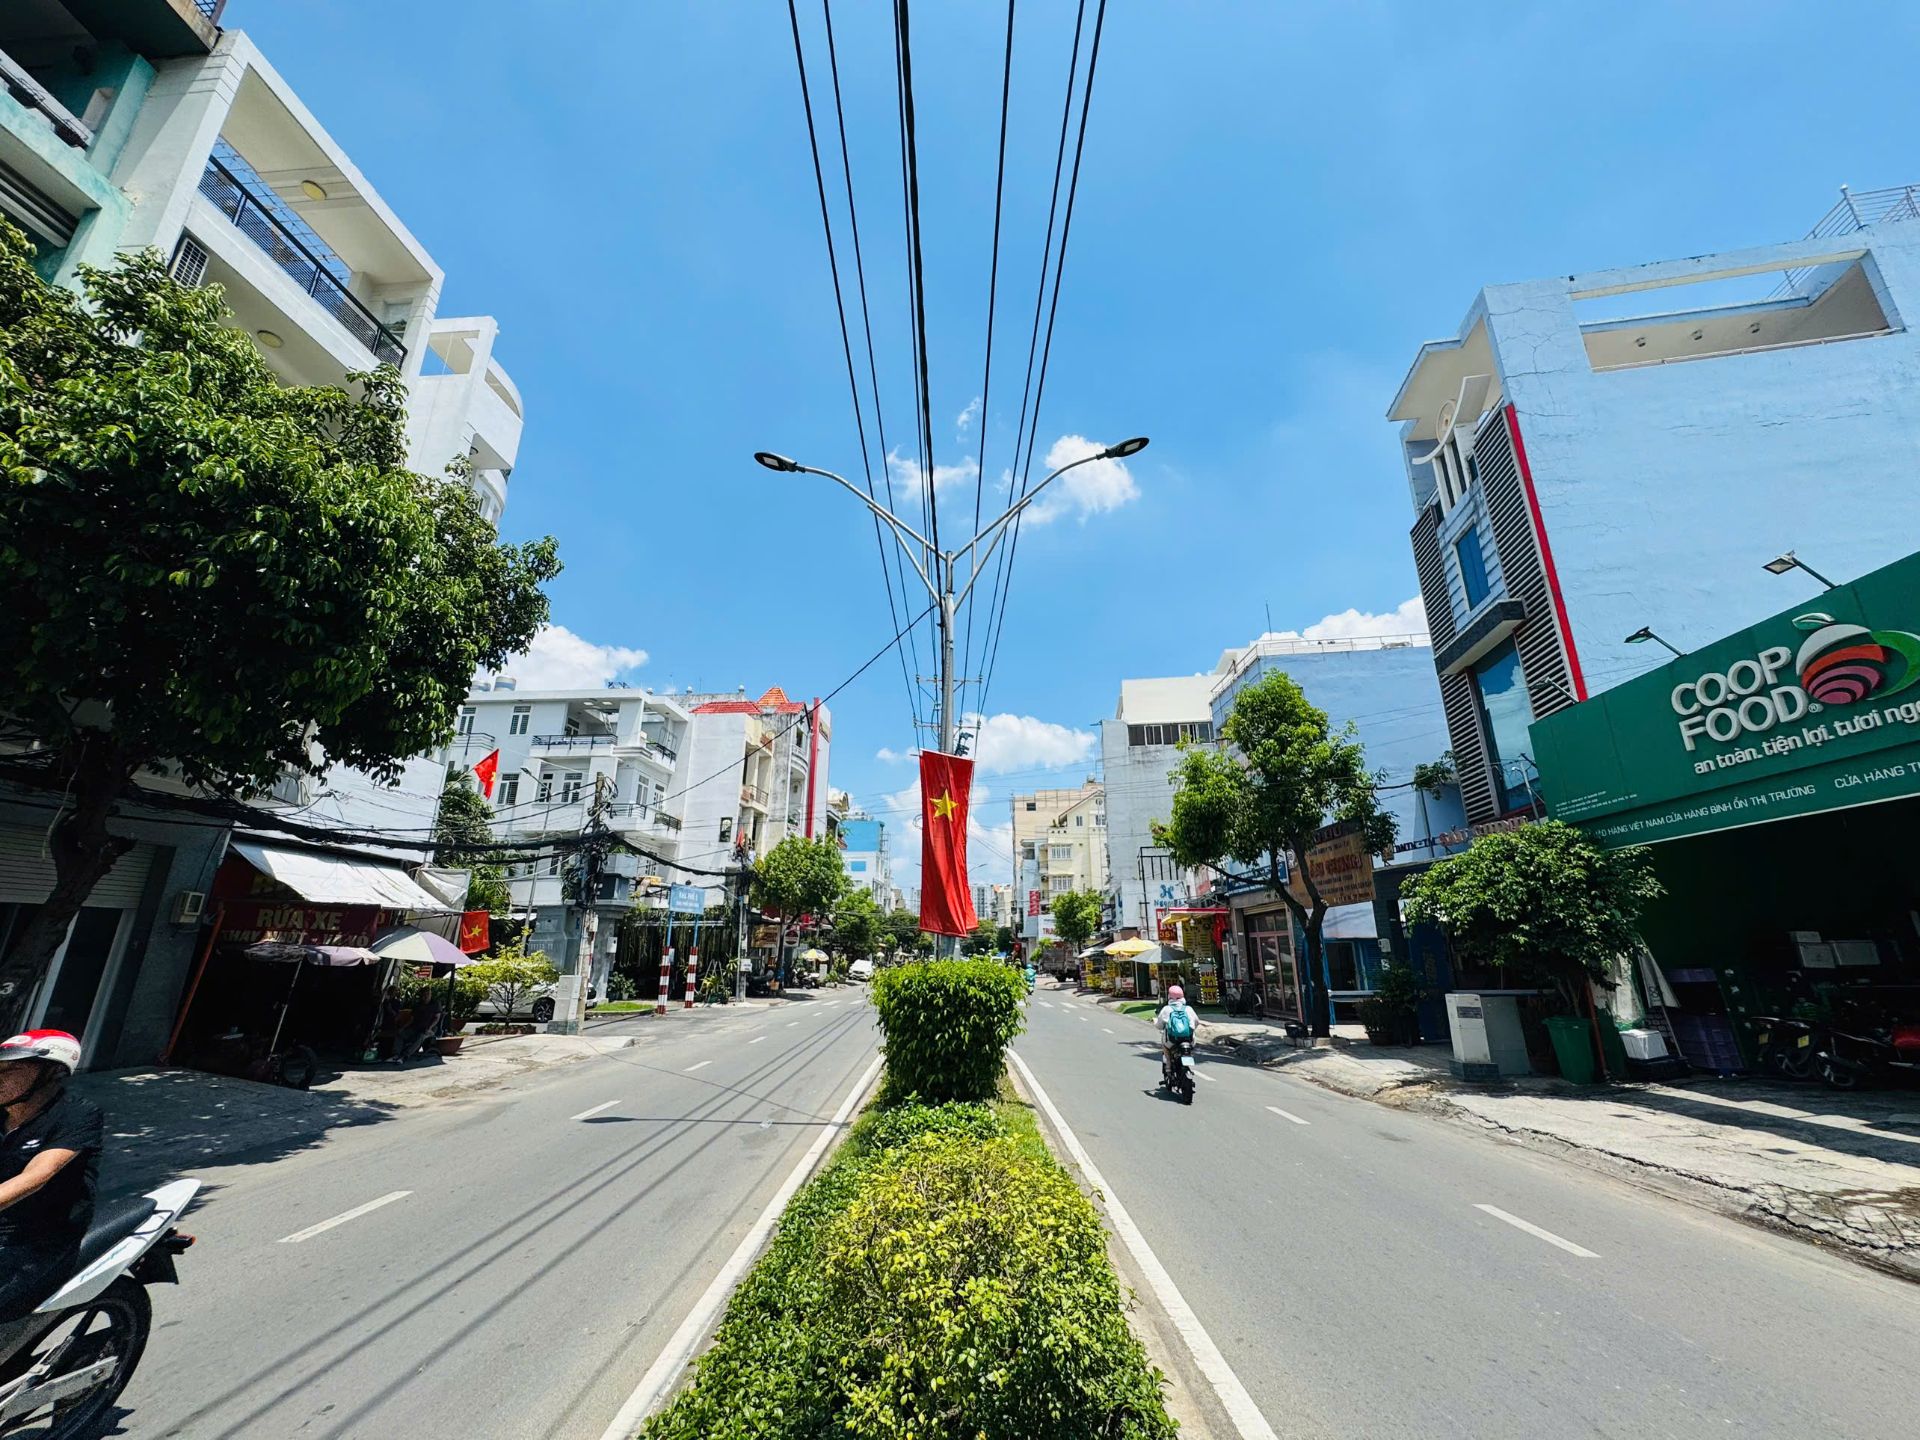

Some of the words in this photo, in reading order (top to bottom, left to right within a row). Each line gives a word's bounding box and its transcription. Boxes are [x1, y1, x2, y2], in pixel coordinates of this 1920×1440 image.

[1694, 758, 1715, 774] an
[1716, 747, 1762, 769] toàn.
[1761, 736, 1803, 756] tiện
[1834, 708, 1883, 736] tươi
[1834, 774, 1862, 789] CỬA
[1863, 765, 1905, 783] HÀNG
[1645, 816, 1665, 828] NAM
[1666, 811, 1683, 823] CỬA
[1684, 806, 1709, 820] HÀNG
[1710, 801, 1733, 814] BÌNH
[1733, 796, 1748, 809] ỔN
[1750, 793, 1768, 806] THỊ
[1768, 785, 1816, 801] TRƯỜNG
[256, 904, 304, 929] RỬA
[310, 909, 345, 931] XE
